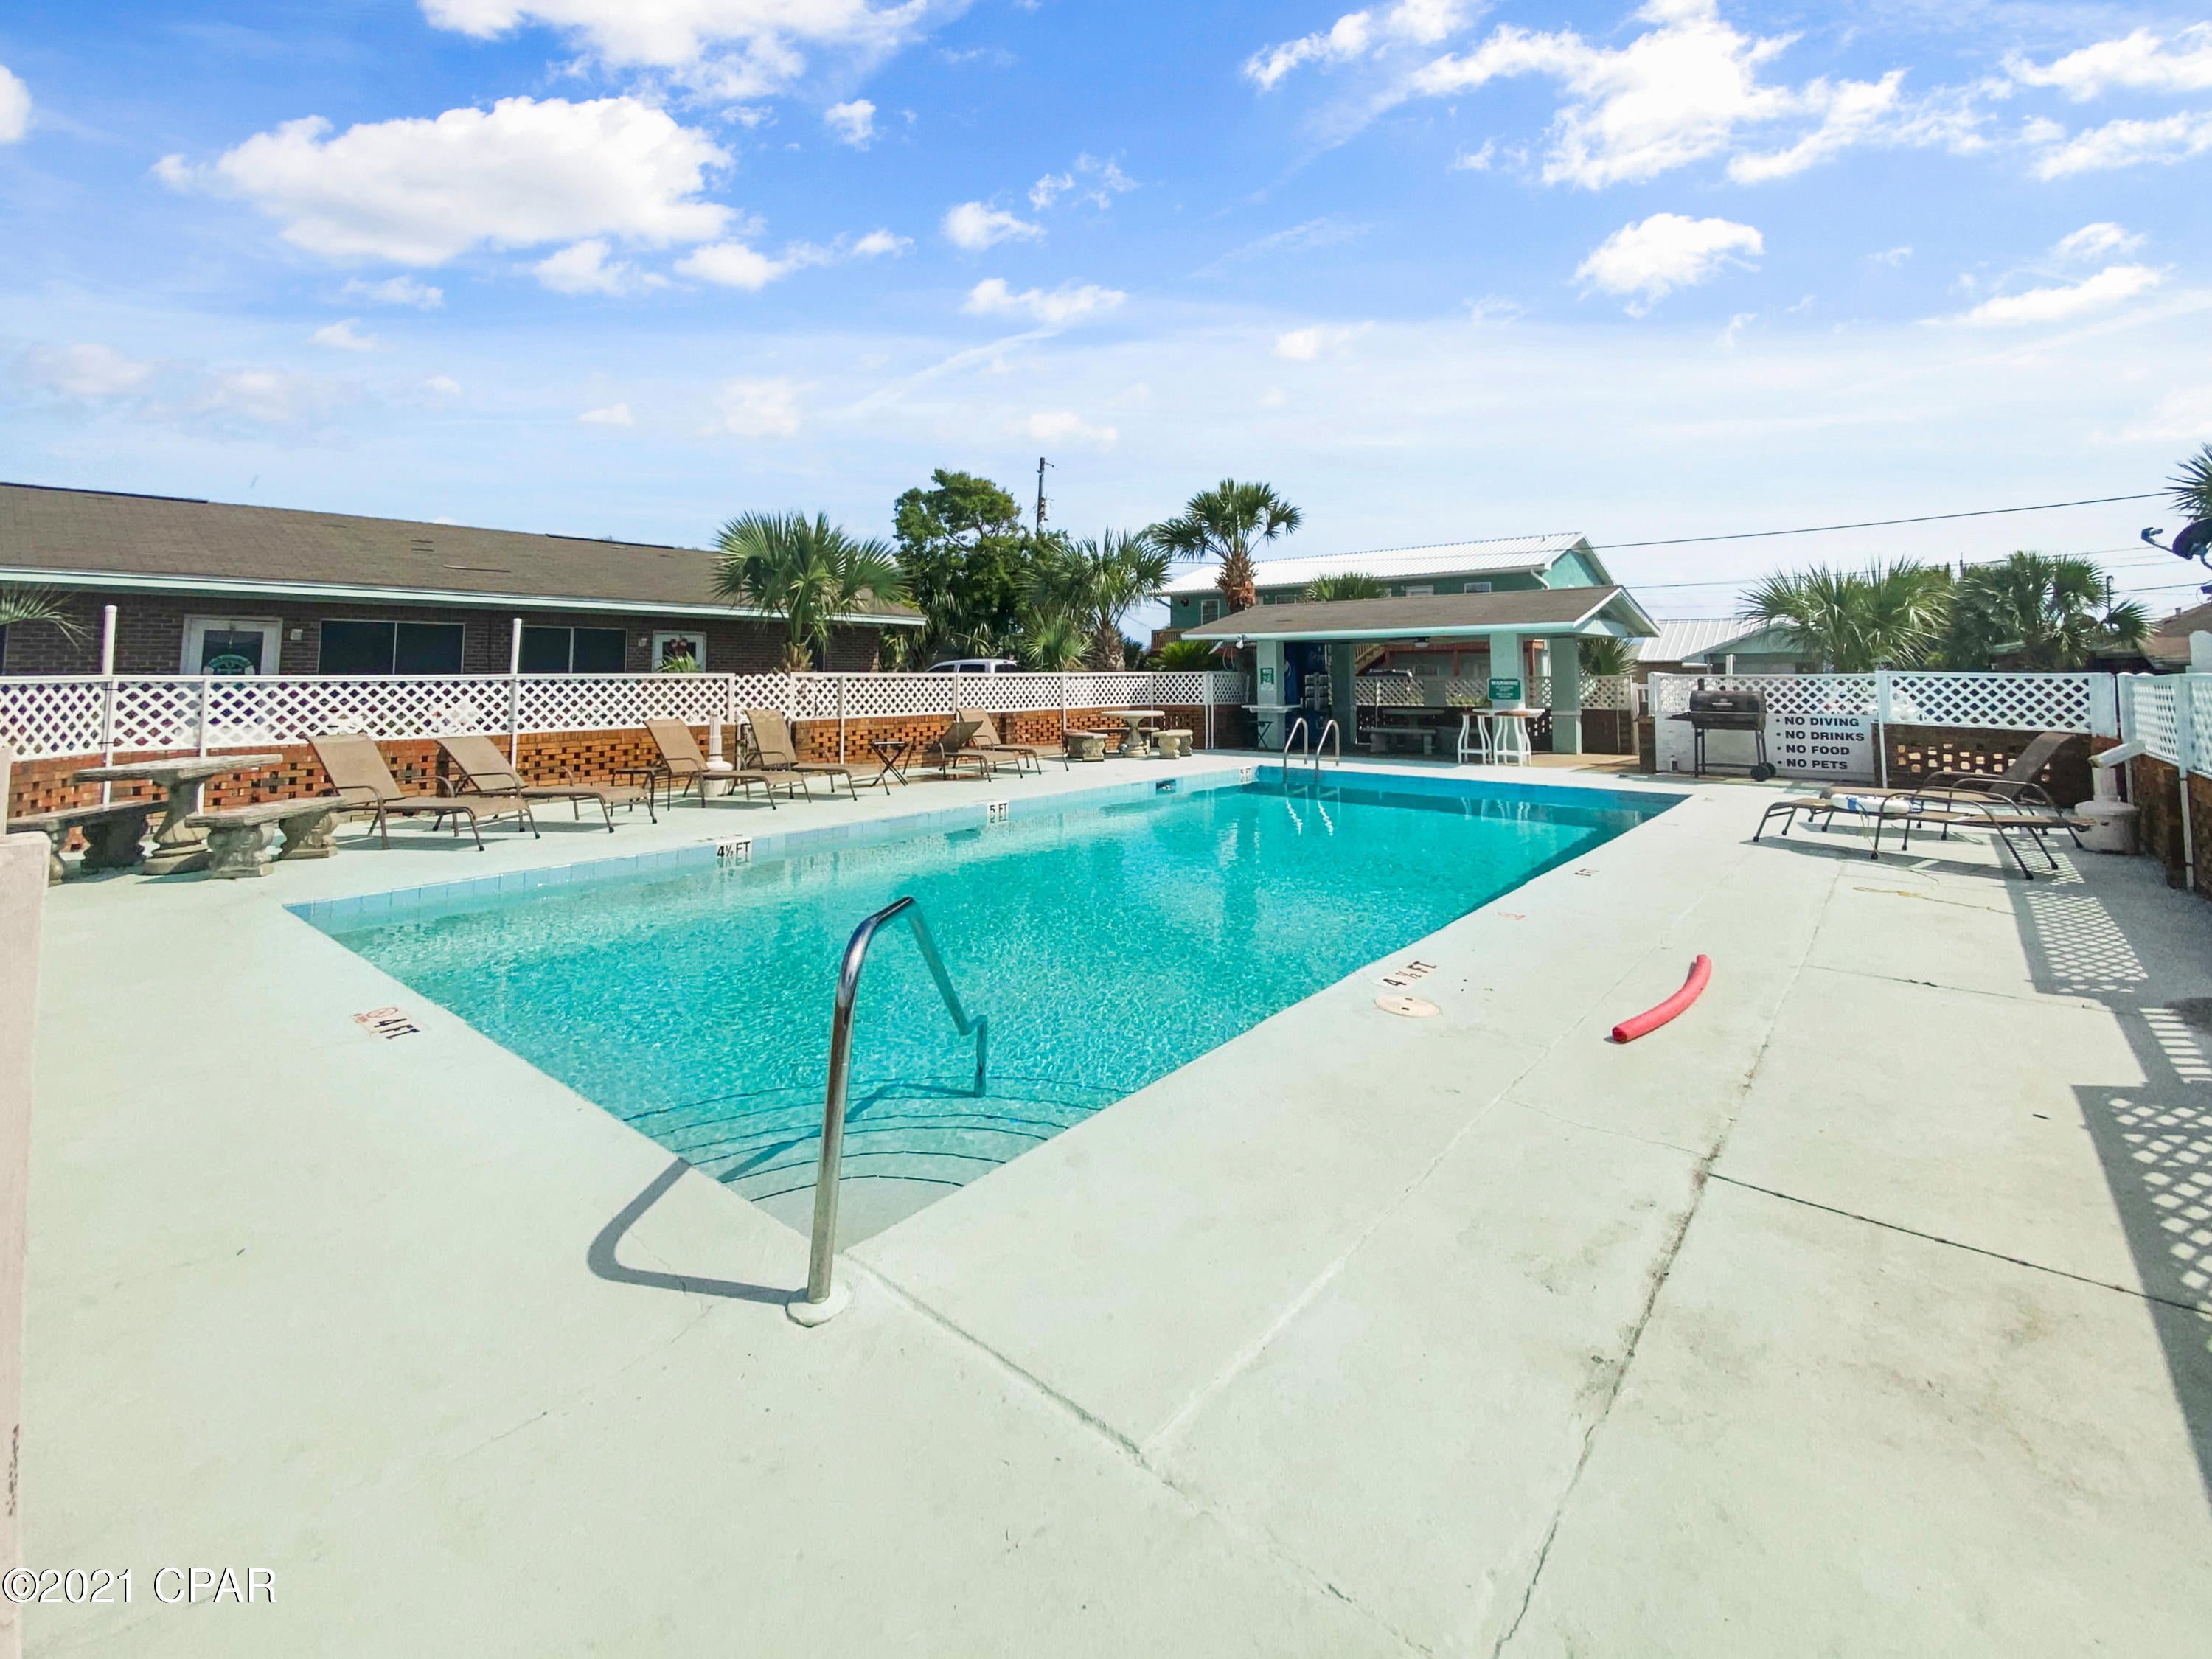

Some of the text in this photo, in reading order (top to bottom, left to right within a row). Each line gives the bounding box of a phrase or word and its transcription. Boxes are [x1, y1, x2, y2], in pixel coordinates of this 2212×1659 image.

[1784, 717, 1860, 727] NO DIVING
[1785, 731, 1865, 742] NO DRINKS
[1786, 745, 1850, 755] NO FOOD
[1787, 759, 1848, 770] NO PETS
[736, 841, 751, 855] FT
